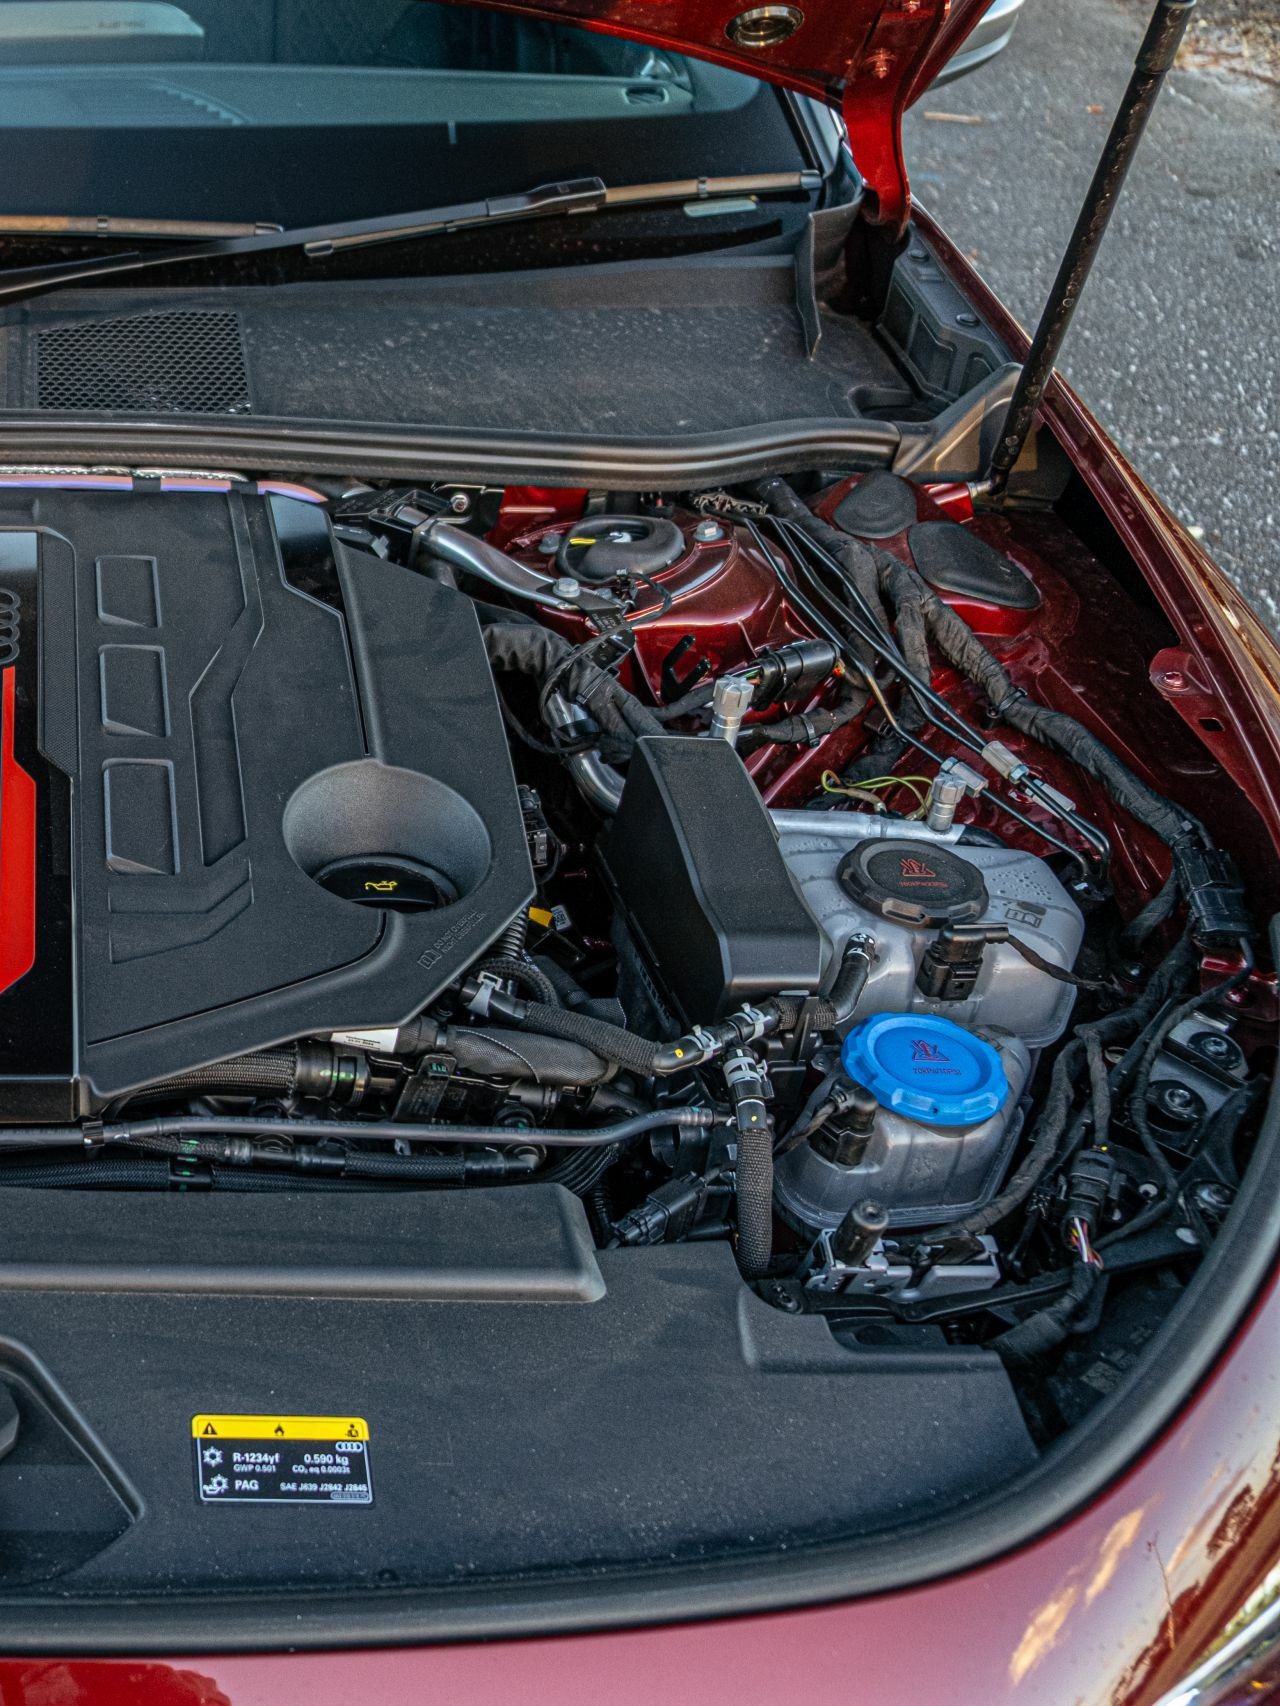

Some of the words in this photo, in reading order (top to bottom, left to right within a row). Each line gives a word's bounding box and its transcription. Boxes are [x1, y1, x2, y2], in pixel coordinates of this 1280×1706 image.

[232, 1452, 280, 1465] R-1234yf
[304, 1453, 333, 1464] 0.590
[335, 1454, 349, 1466] kg
[233, 1464, 254, 1473] GWP
[234, 1479, 259, 1491] PAG
[280, 1482, 297, 1491] SAE
